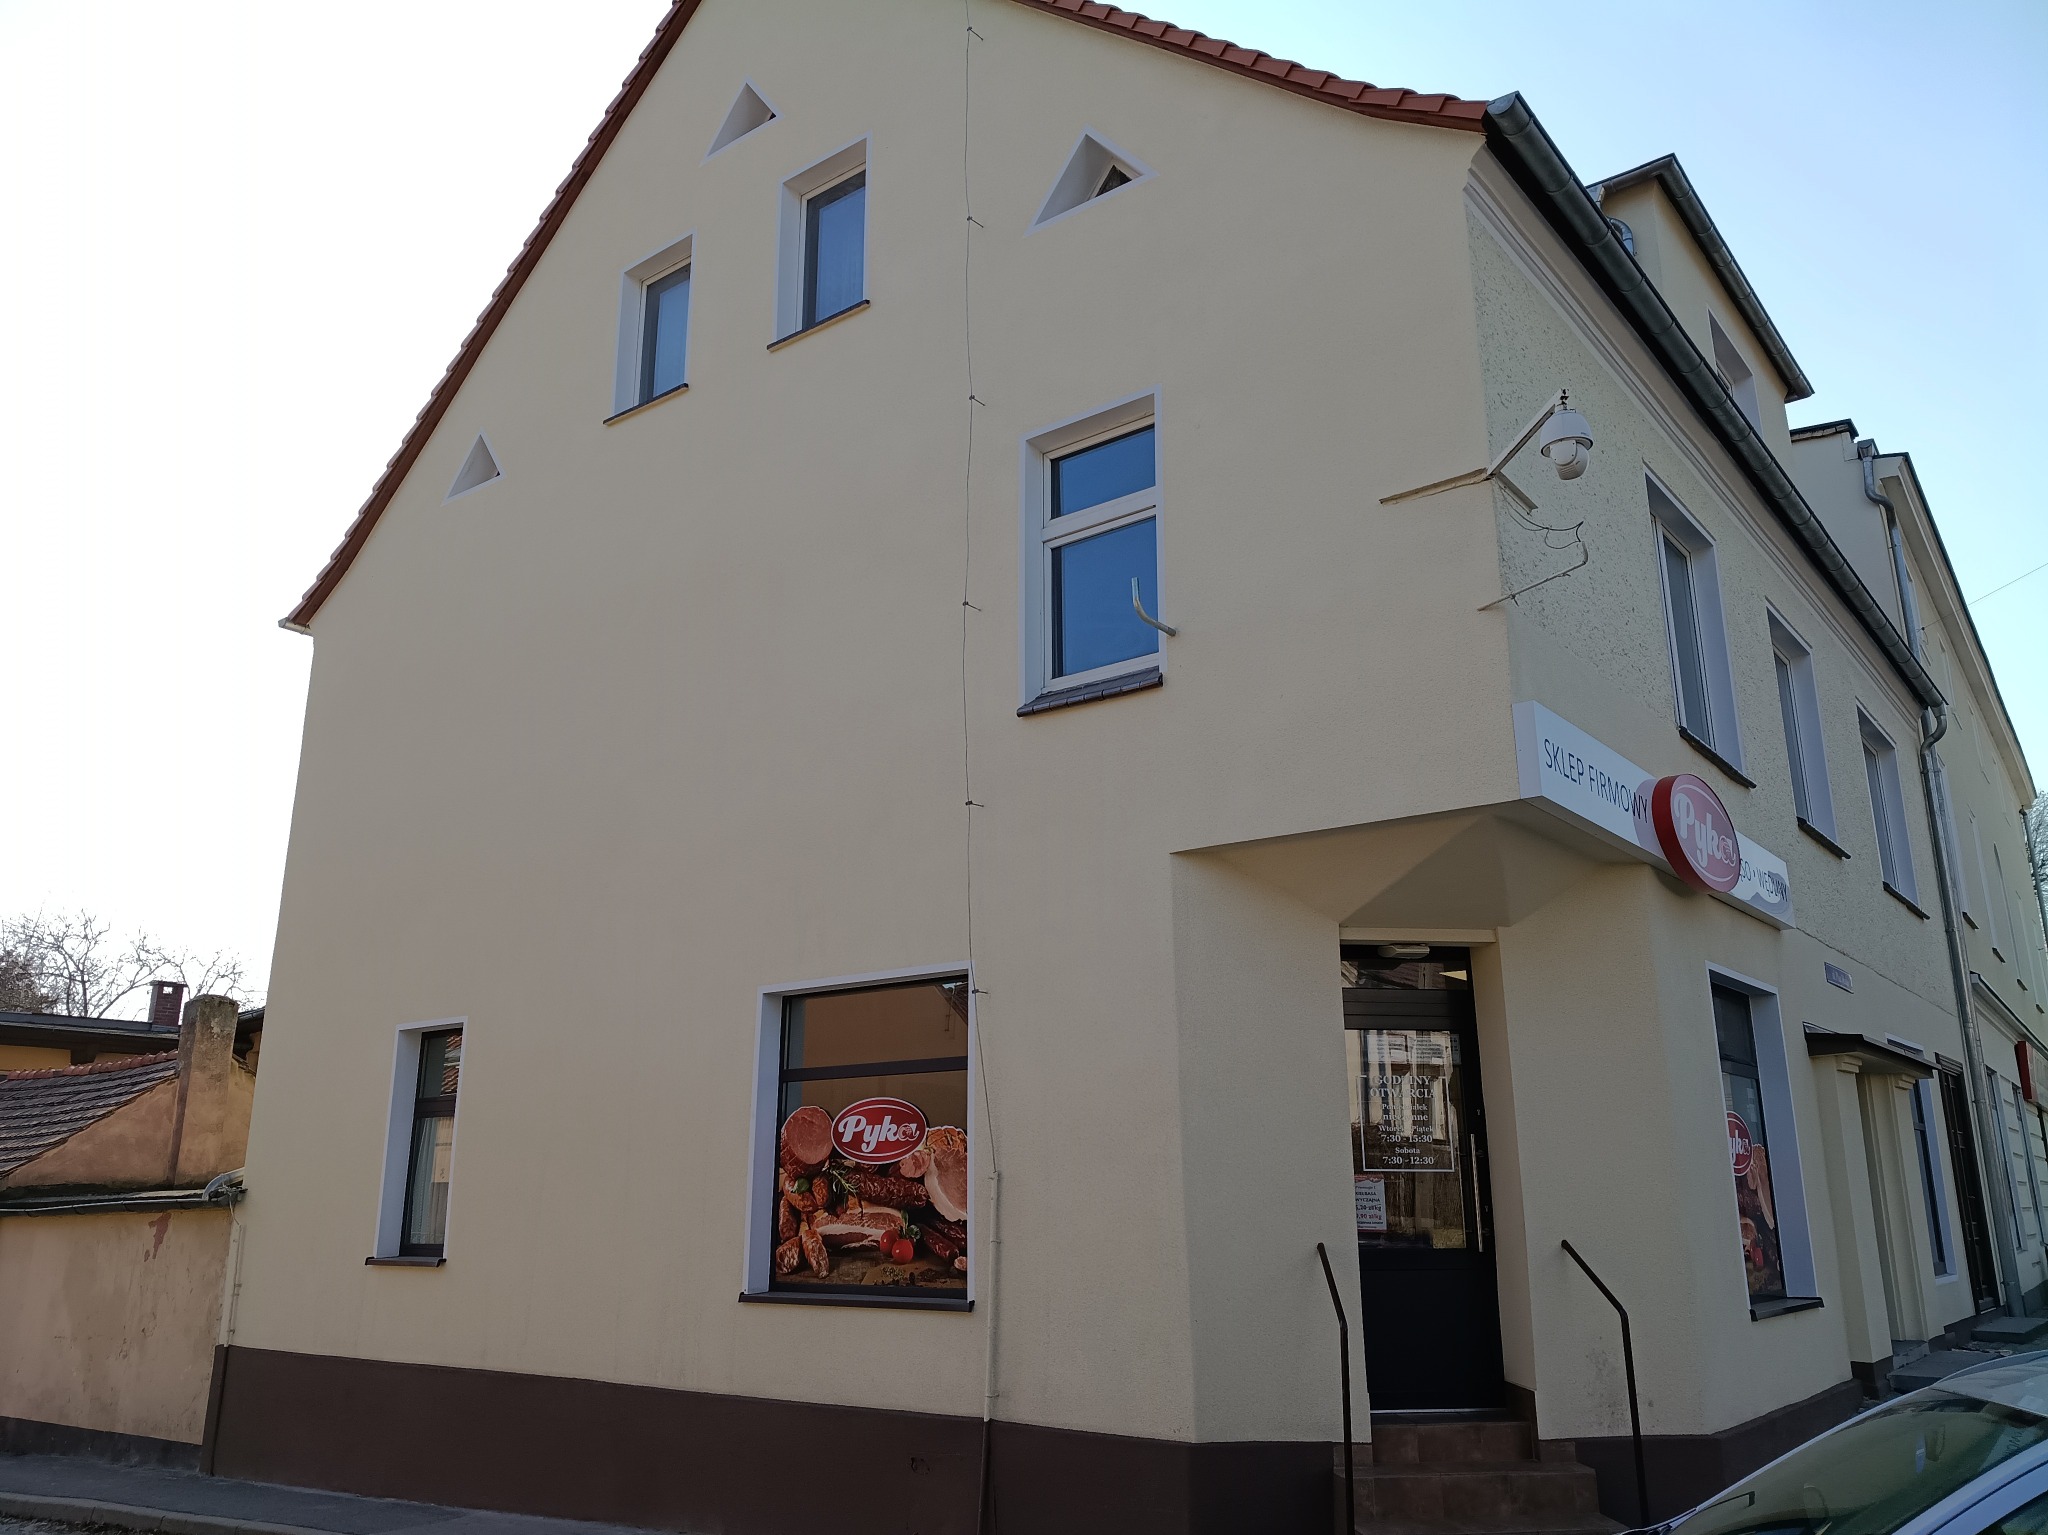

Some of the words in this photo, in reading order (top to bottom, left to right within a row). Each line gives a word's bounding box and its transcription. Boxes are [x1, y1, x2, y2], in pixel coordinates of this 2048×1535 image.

[1544, 738, 1584, 785] SKLEP
[1588, 764, 1648, 823] FIRMOWY
[1673, 792, 1736, 868] Pyka
[1373, 1075, 1432, 1085] GODINY
[1370, 1088, 1434, 1098] OTWRCIA
[838, 1115, 920, 1152] Pyka
[1380, 1134, 1401, 1143] 7:30
[1408, 1134, 1433, 1143] 15:30
[1394, 1146, 1421, 1154] Sobota
[1729, 1130, 1751, 1164] yka
[1382, 1156, 1403, 1165] 7:30
[1410, 1156, 1434, 1165] 12:30
